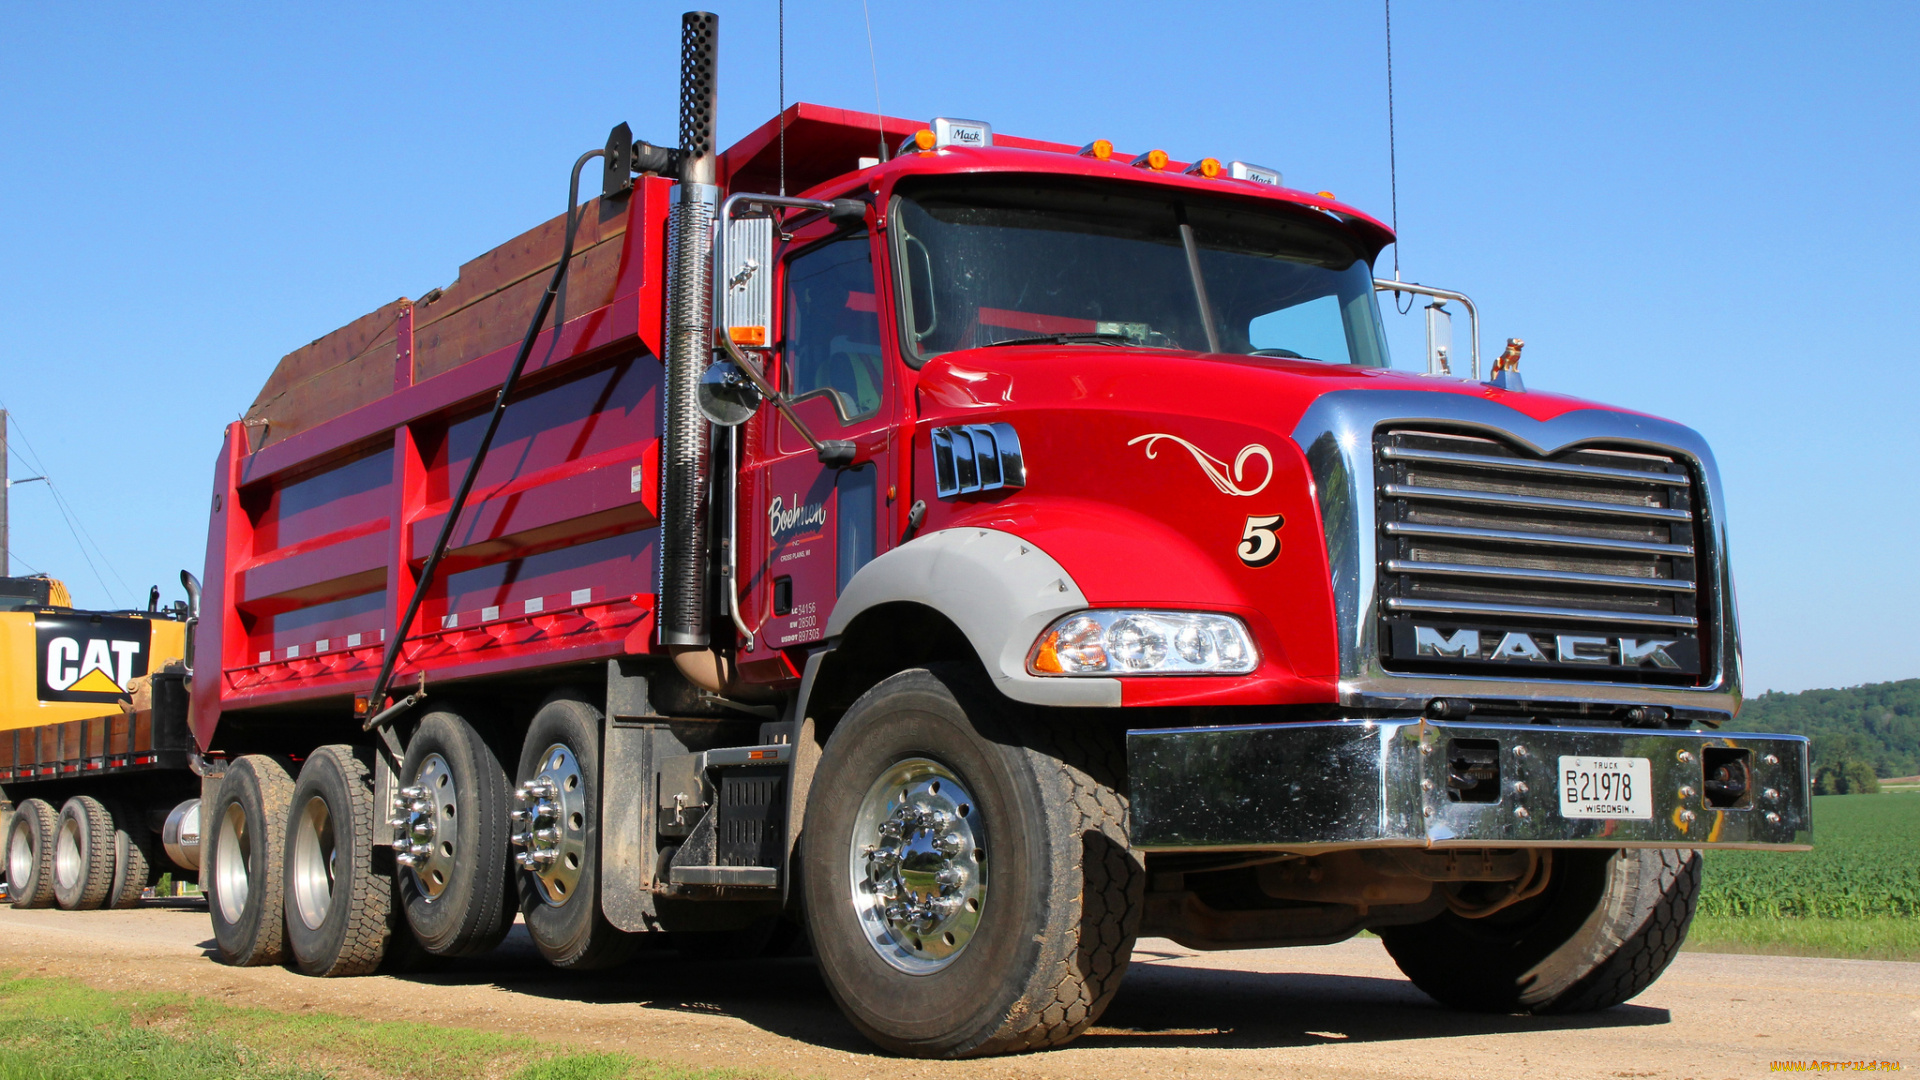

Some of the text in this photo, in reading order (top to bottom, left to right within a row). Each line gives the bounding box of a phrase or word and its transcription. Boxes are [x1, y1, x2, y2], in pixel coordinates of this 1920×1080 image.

[953, 129, 980, 141] Mack
[768, 493, 826, 537] Boehnen
[1237, 514, 1284, 567] 5
[781, 553, 793, 562] CROSS
[791, 602, 816, 616] LC 34156
[798, 615, 817, 628] 28500
[781, 628, 820, 643] USDOT 897303
[1414, 625, 1682, 670] MACK
[46, 636, 140, 694] CAT
[1580, 772, 1632, 801] 21978
[1586, 804, 1629, 813] WISCONSIN
